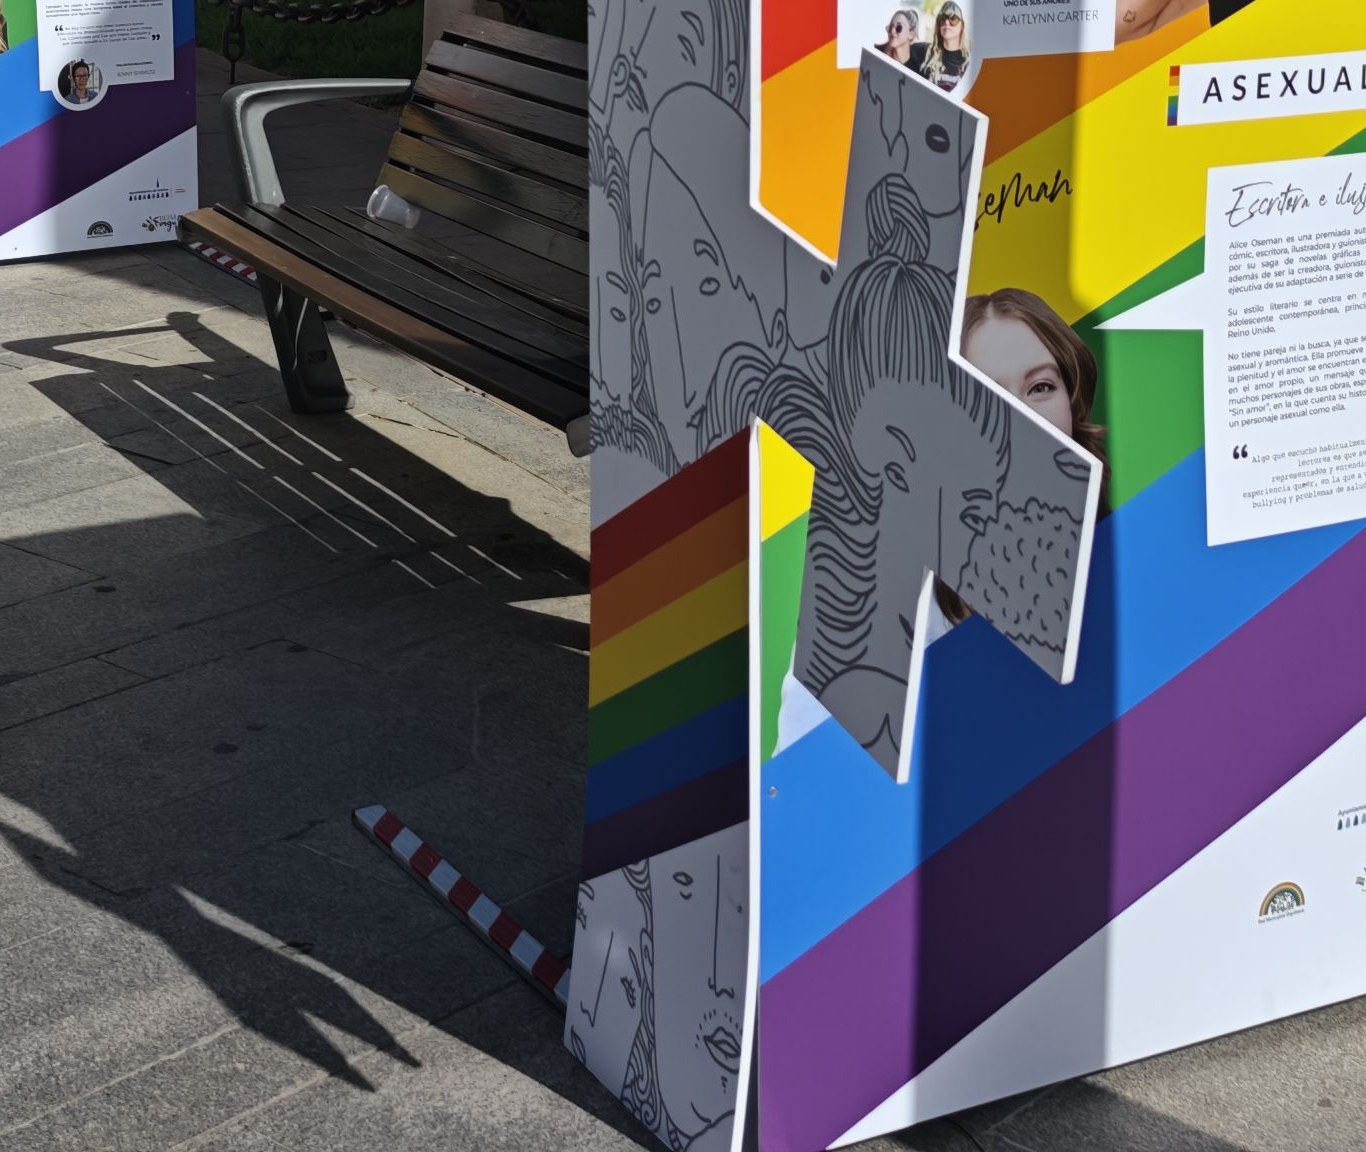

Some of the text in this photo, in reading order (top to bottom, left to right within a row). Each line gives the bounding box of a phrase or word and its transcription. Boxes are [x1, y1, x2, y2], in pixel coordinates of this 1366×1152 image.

[1003, 10, 1099, 25] KAITLYNN CARTER
[974, 169, 1073, 232] eman
[1225, 181, 1310, 228] Escritora
[1319, 193, 1327, 206] e
[1228, 239, 1247, 249] Alice
[1251, 235, 1282, 247] Oseman
[1315, 228, 1350, 241] premiada
[1228, 250, 1253, 261] cómic,
[1255, 246, 1289, 258] escritora,
[1291, 241, 1330, 253] ilustradora
